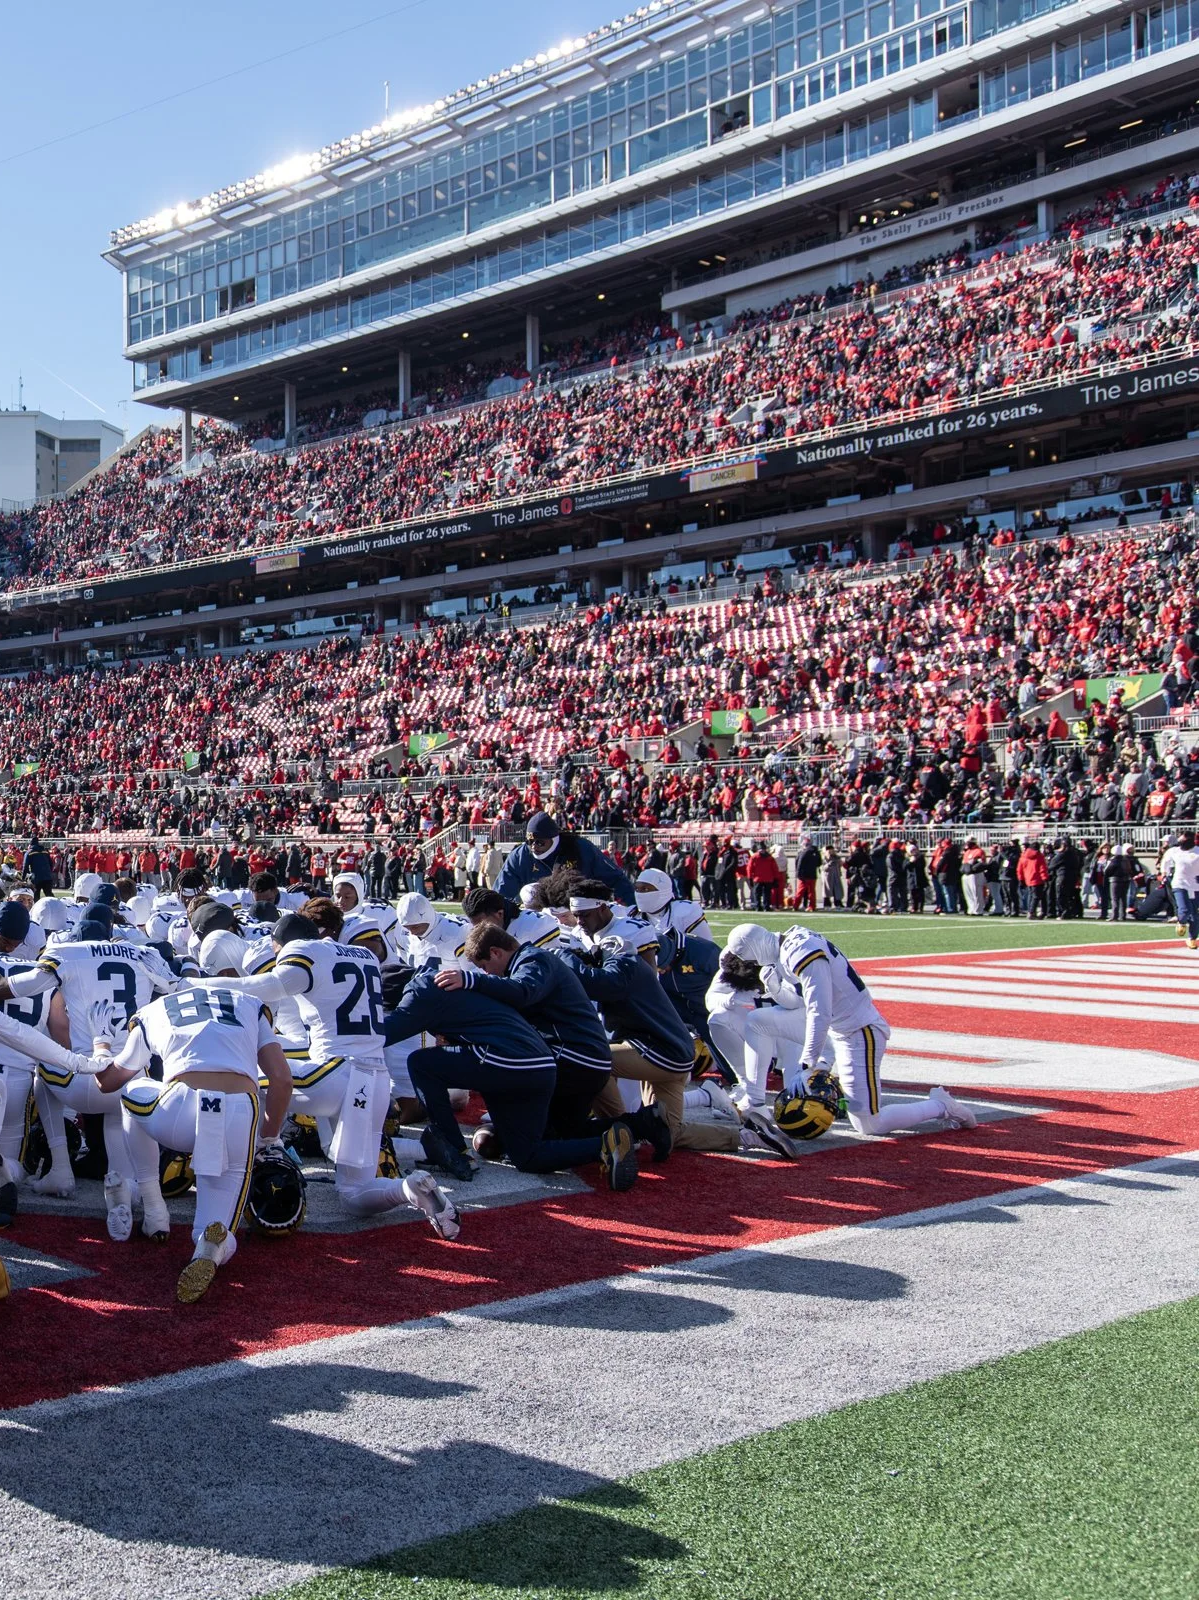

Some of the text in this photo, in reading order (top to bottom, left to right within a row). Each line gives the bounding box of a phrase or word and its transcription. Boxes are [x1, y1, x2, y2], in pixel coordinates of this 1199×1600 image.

[860, 195, 1004, 245] The Shelly Family Pressbox
[1080, 367, 1199, 405] The James
[796, 402, 1043, 465] Nationally ranked for 26 years.
[710, 468, 736, 482] CANCER
[611, 495, 630, 504] CANCER
[630, 491, 649, 500] CENTER
[491, 504, 559, 527] The James
[323, 522, 471, 558] Nationally ranked for 26 years.
[90, 944, 138, 961] MOORE
[333, 943, 375, 960] JOHNSON
[681, 964, 694, 973] M
[97, 961, 138, 1031] 3
[163, 988, 244, 1028] 81
[201, 1097, 221, 1113] M
[353, 1098, 366, 1109] M
